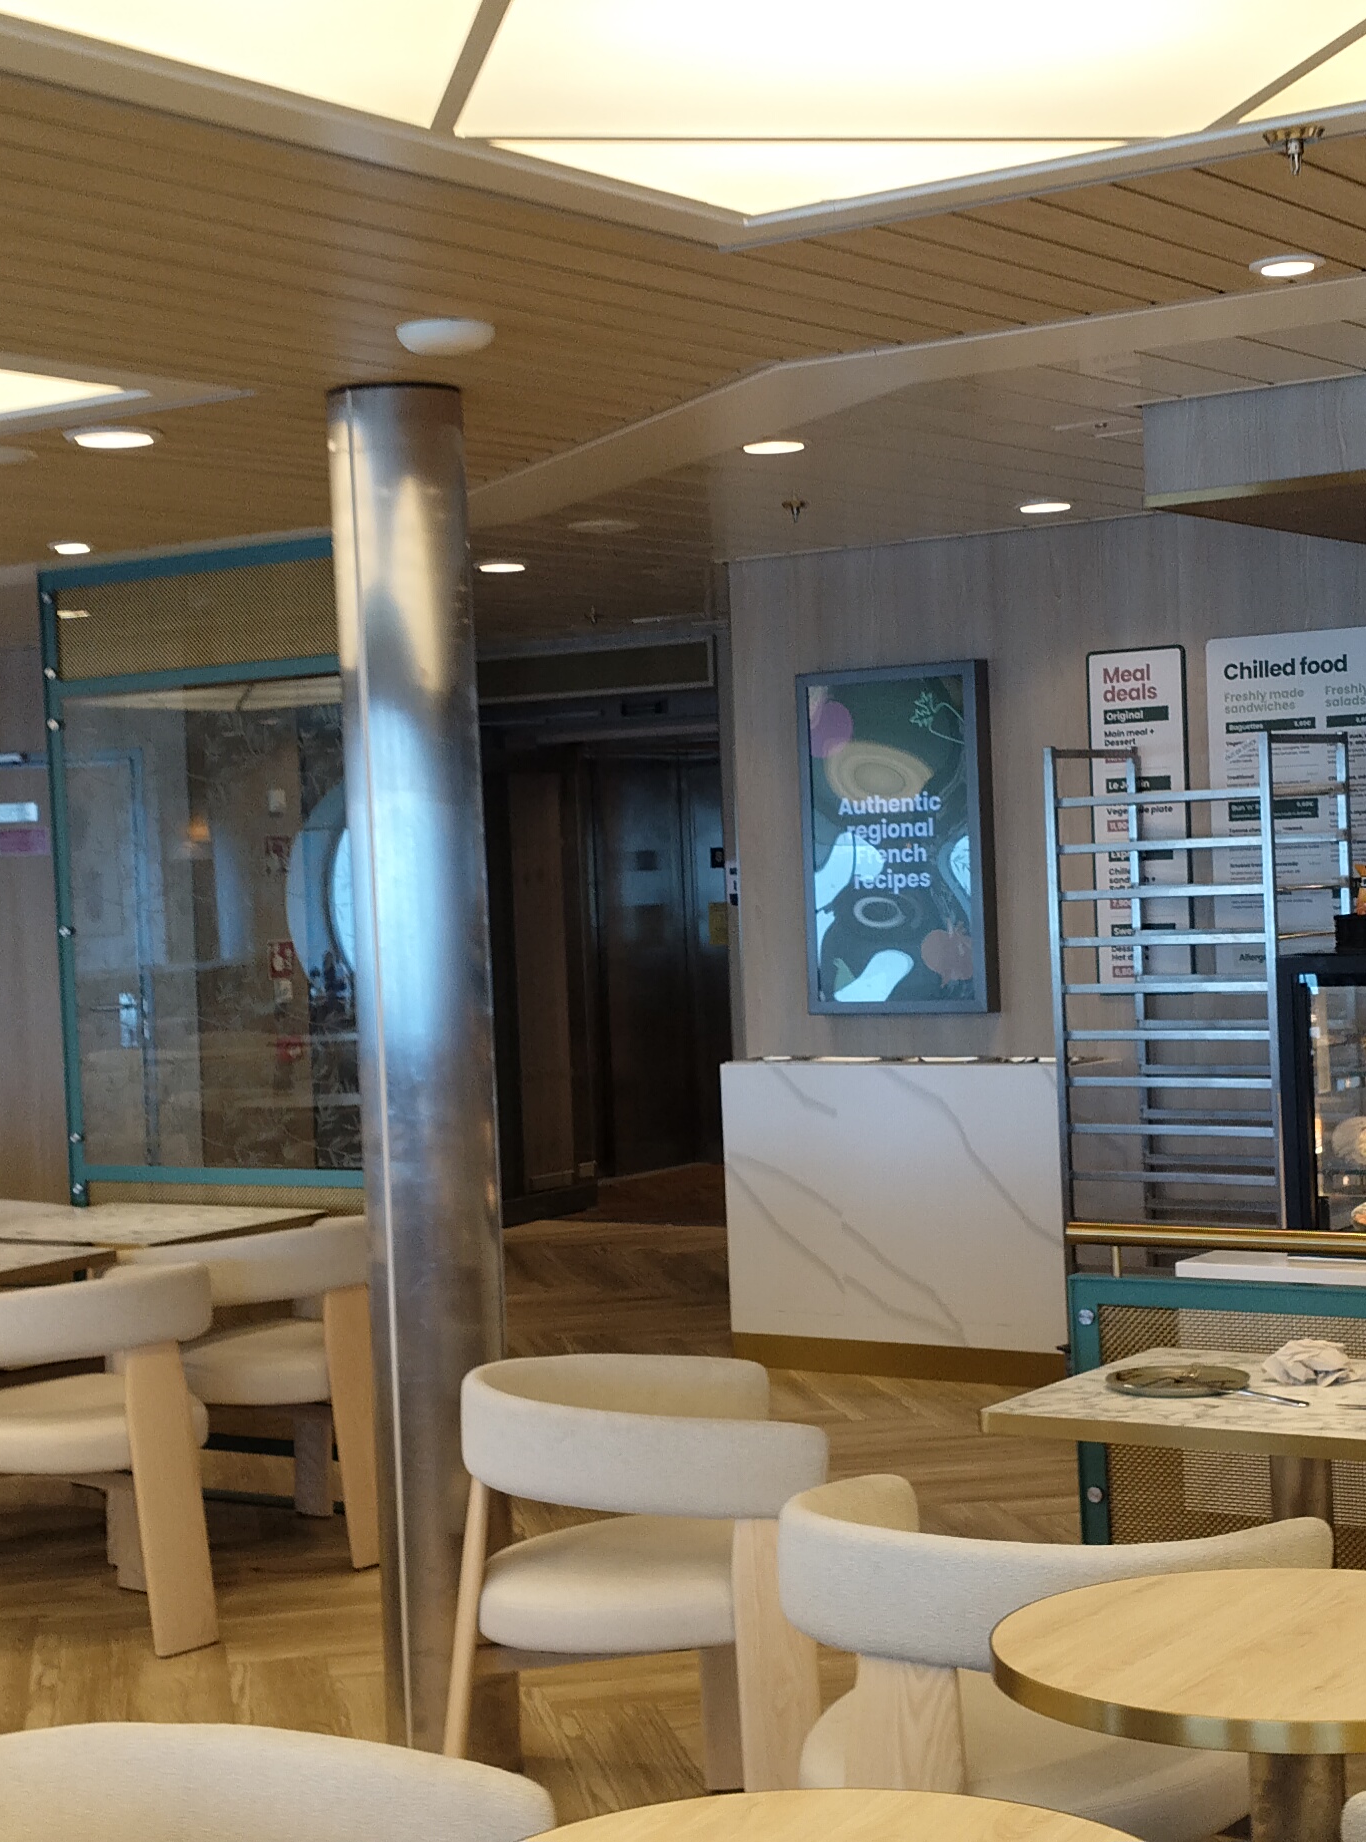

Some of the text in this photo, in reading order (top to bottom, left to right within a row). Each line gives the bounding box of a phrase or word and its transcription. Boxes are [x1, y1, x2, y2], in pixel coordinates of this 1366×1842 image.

[1103, 663, 1151, 684] Meal
[1224, 654, 1348, 681] Chilled food
[1103, 683, 1158, 703] deals
[1224, 688, 1304, 703] Freshly made
[1224, 700, 1296, 714] sandwiches
[1325, 695, 1366, 707] salads
[1106, 710, 1144, 722] Original
[1104, 730, 1125, 738] Main
[1126, 728, 1148, 737] meal
[1104, 738, 1136, 747] Dessert
[1108, 781, 1119, 790] Le
[838, 791, 941, 815] Authentic
[1151, 805, 1173, 816] plate
[846, 818, 933, 844] regional
[857, 845, 927, 864] French
[854, 870, 931, 893] recipes
